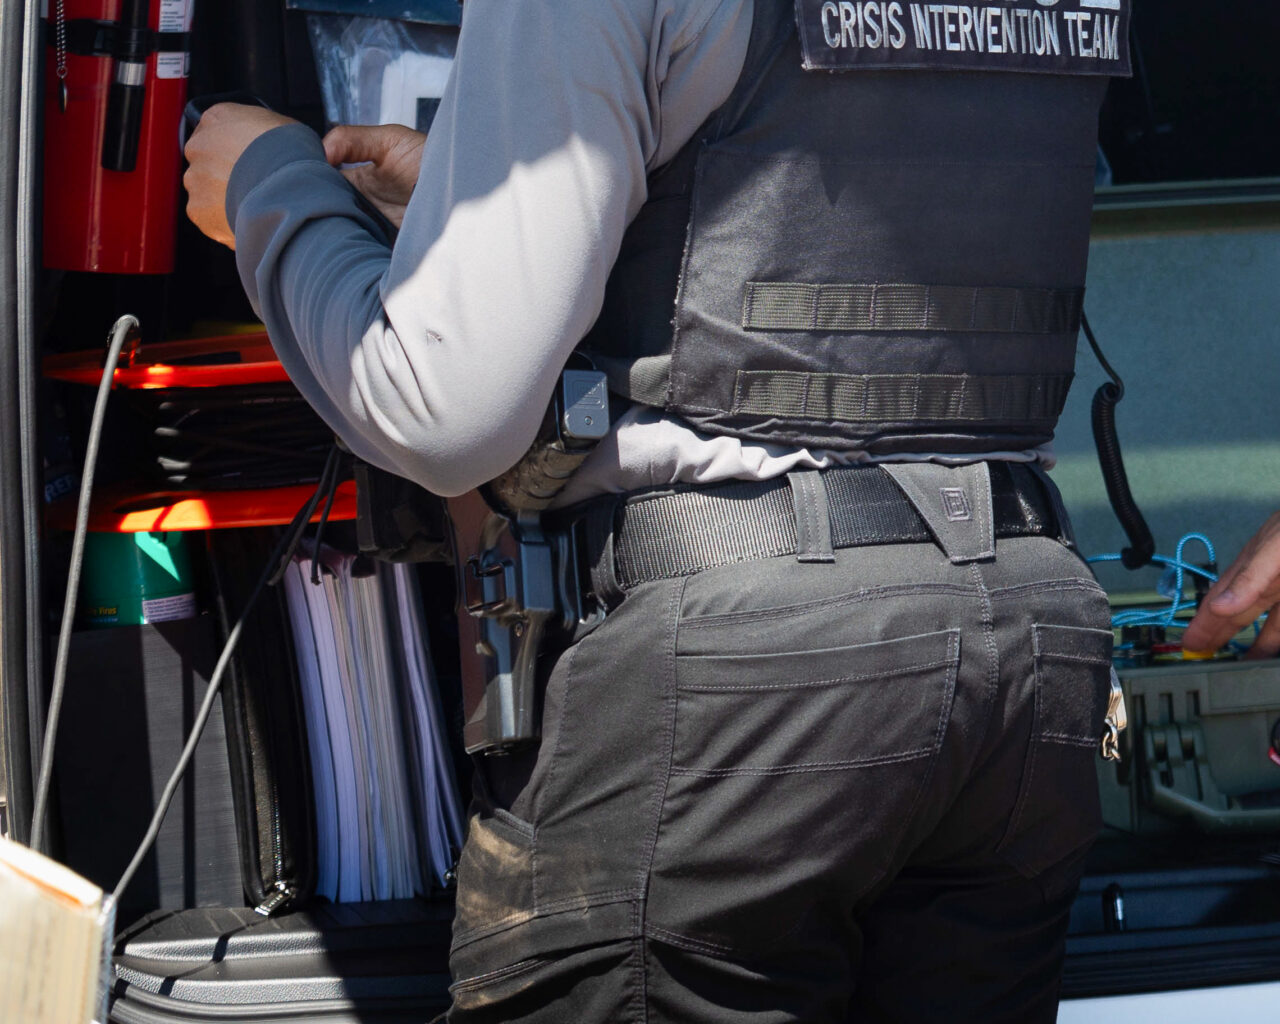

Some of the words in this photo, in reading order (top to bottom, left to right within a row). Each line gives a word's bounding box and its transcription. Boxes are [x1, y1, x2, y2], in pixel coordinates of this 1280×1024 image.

[821, 0, 906, 50] CRISIS
[910, 3, 1060, 57] INTERVENTION
[1063, 11, 1120, 61] TEAM
